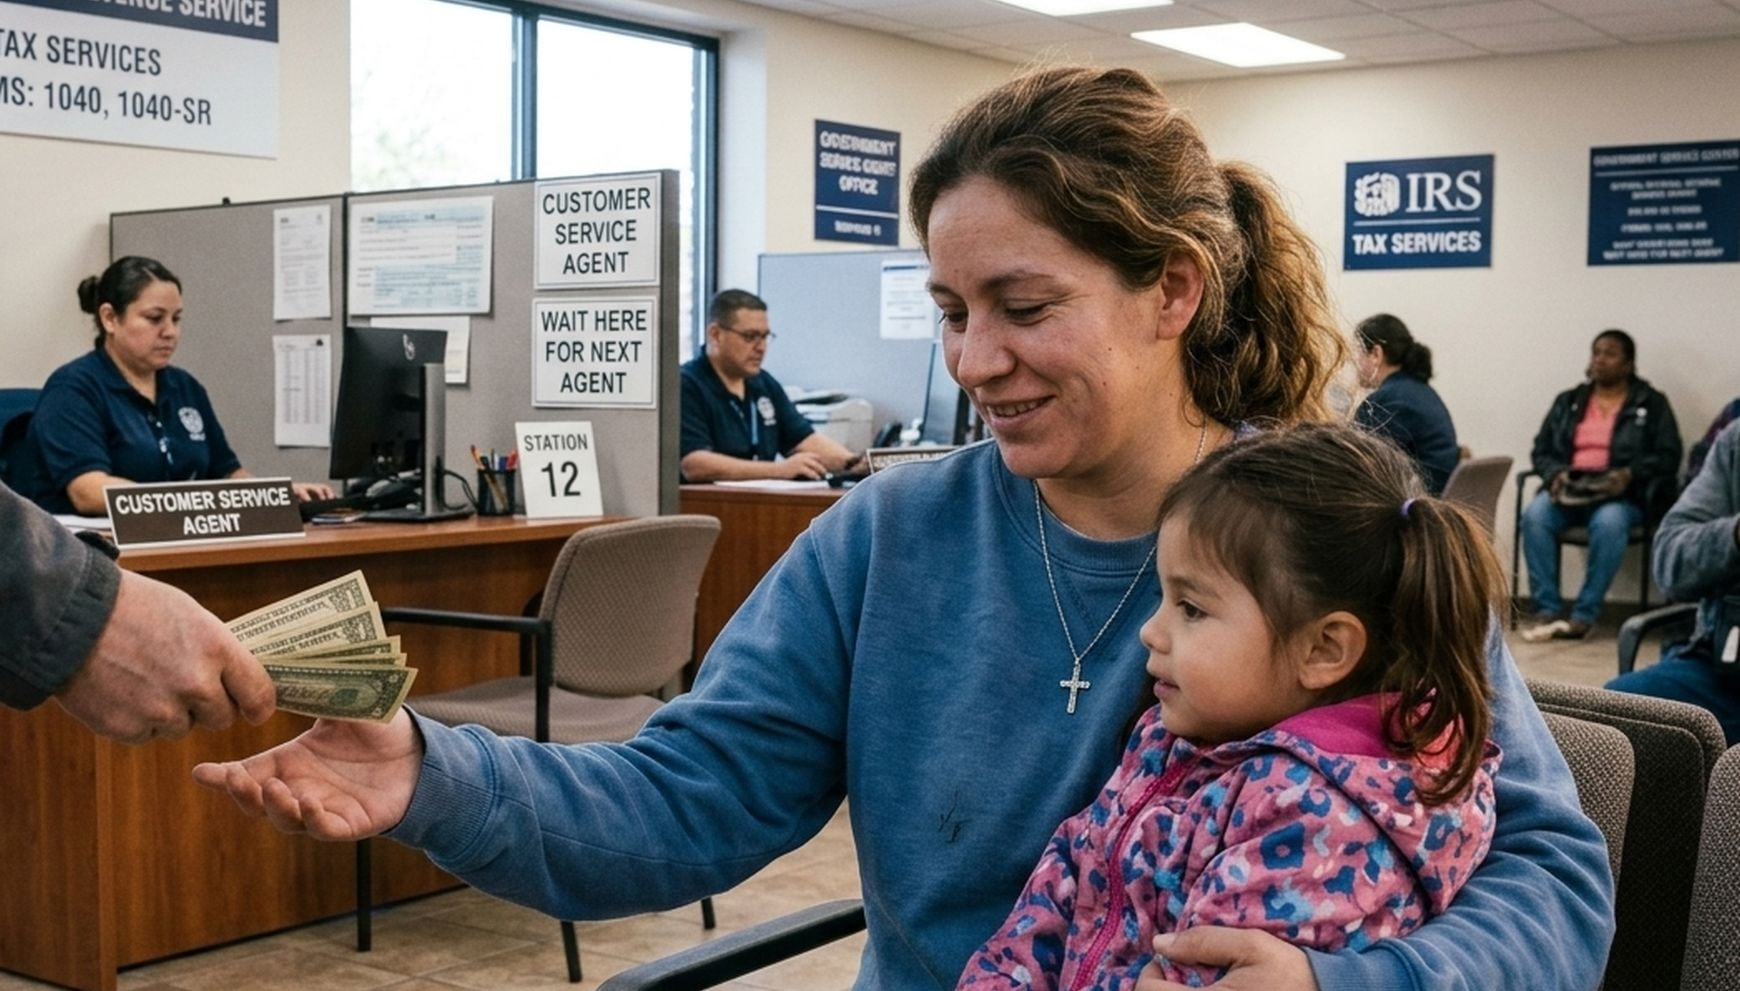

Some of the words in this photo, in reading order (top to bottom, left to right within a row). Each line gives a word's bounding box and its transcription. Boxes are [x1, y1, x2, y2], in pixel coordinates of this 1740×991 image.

[179, 0, 267, 27] SERVICE
[46, 34, 162, 76] SERVICES
[44, 81, 109, 119] 1040,
[118, 91, 211, 125] 1040-SR
[543, 187, 651, 215] CUSTOMER
[1405, 170, 1482, 213] IRS
[555, 219, 637, 245] SERVICE
[1352, 233, 1388, 255] TAX
[1391, 231, 1482, 254] SERVICES
[562, 251, 629, 275] AGENT
[541, 310, 589, 332] WAIT
[595, 310, 647, 332] HERE
[546, 341, 585, 363] FOR
[591, 341, 642, 363] NEXT
[560, 372, 627, 394] AGENT
[524, 434, 588, 452] STATION
[541, 461, 581, 497] 12
[115, 490, 216, 515] CUSTOMER
[217, 487, 291, 510] SERVICE
[183, 513, 241, 535] AGENT
